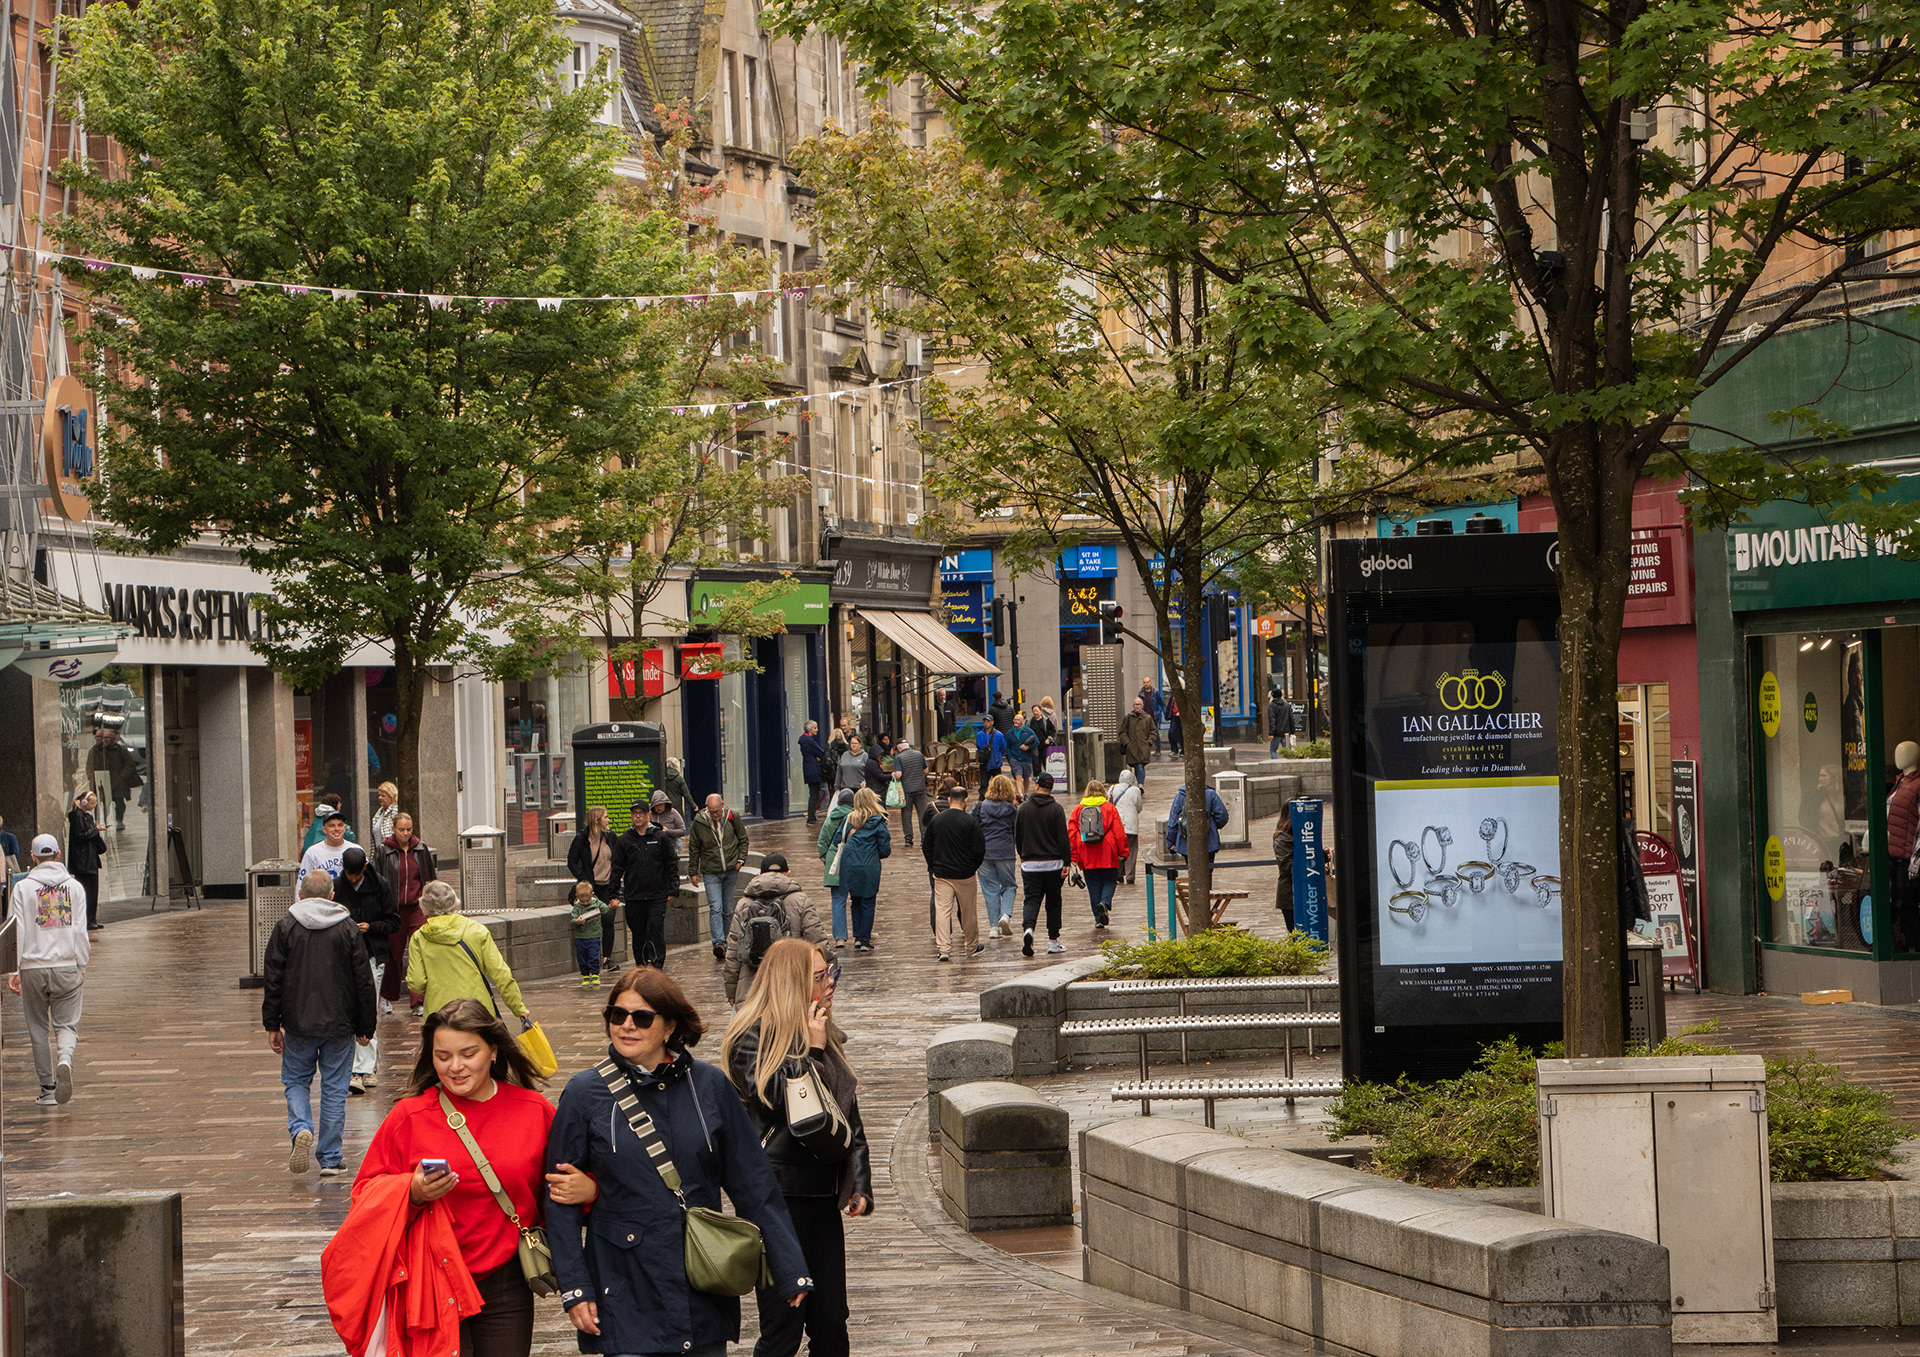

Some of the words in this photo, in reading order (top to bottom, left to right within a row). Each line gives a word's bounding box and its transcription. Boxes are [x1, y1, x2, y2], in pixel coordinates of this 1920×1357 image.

[1752, 522, 1868, 568] MOUNTAIN
[1360, 554, 1412, 577] global
[941, 589, 970, 598] estaurant
[1628, 582, 1668, 594] REPAIRS
[1805, 710, 1817, 721] 40%
[1402, 716, 1432, 732] IAN
[1437, 712, 1543, 732] GALLACHER
[1449, 734, 1475, 742] jeweller
[1844, 742, 1856, 754] FOR
[1421, 766, 1450, 775] Leading
[1465, 766, 1480, 774] way
[1491, 763, 1526, 772] Diamonds
[1302, 821, 1314, 842] life
